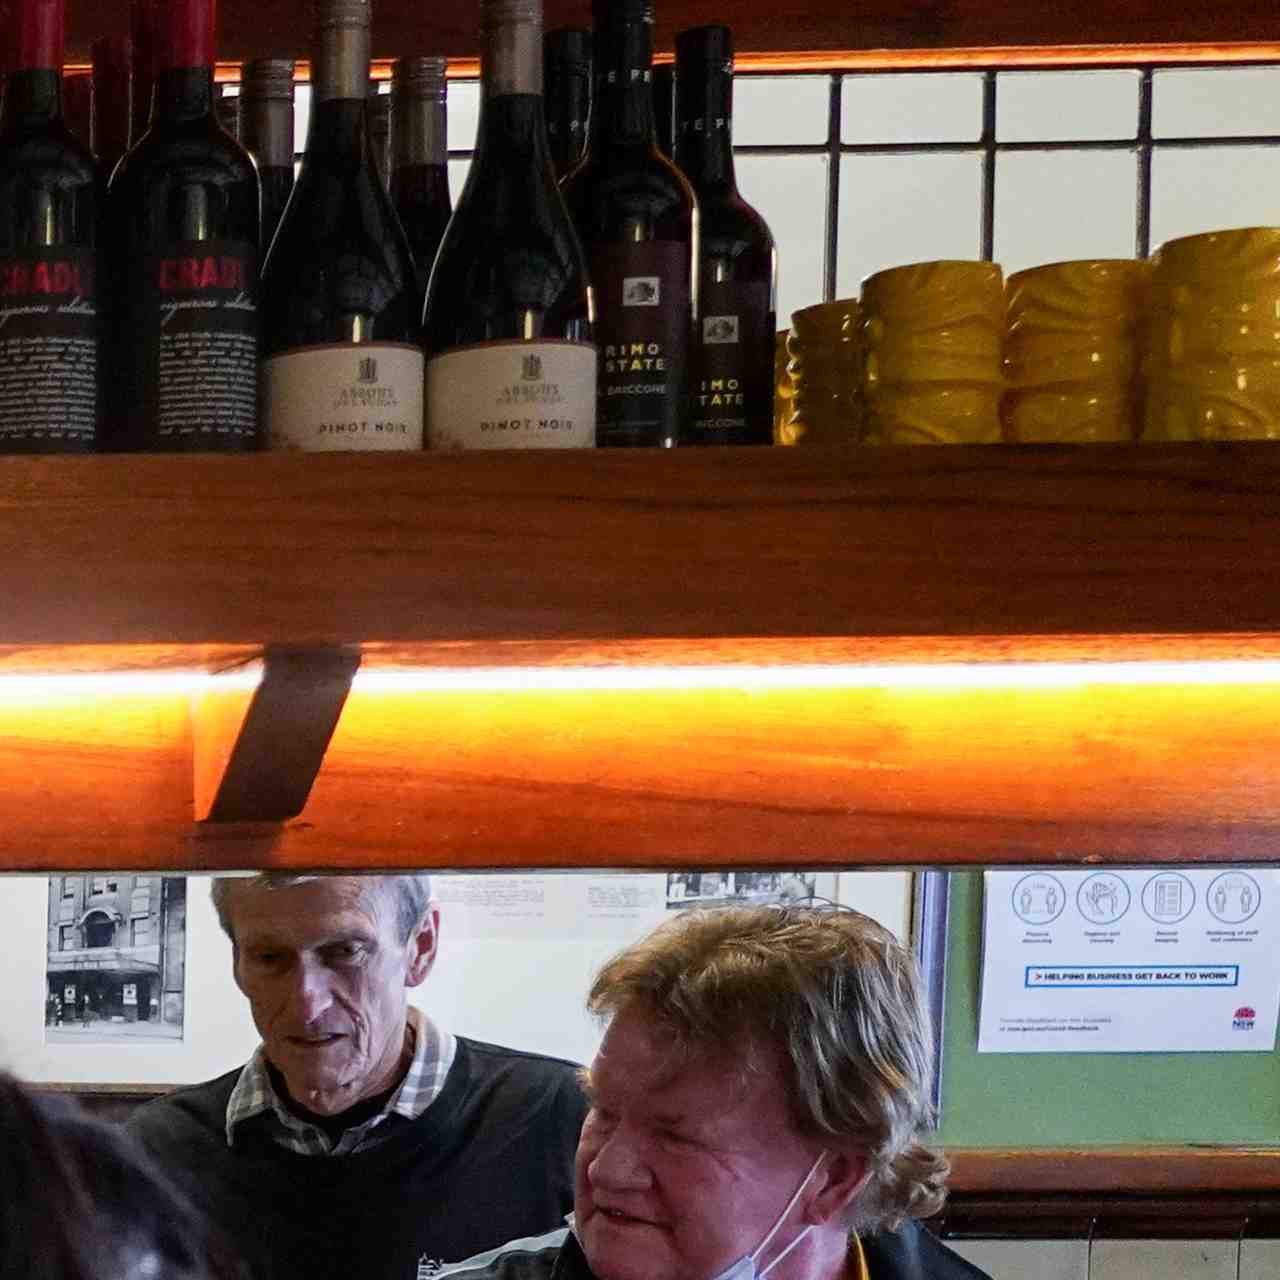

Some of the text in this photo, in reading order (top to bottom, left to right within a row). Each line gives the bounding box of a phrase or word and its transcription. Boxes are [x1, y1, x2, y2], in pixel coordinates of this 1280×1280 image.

[604, 343, 660, 358] RIMO
[604, 358, 666, 374] STATE
[700, 379, 740, 392] IMO
[698, 393, 745, 407] TATE
[1043, 971, 1229, 982] HELPING BUSINESS GET BACK TO WORK
